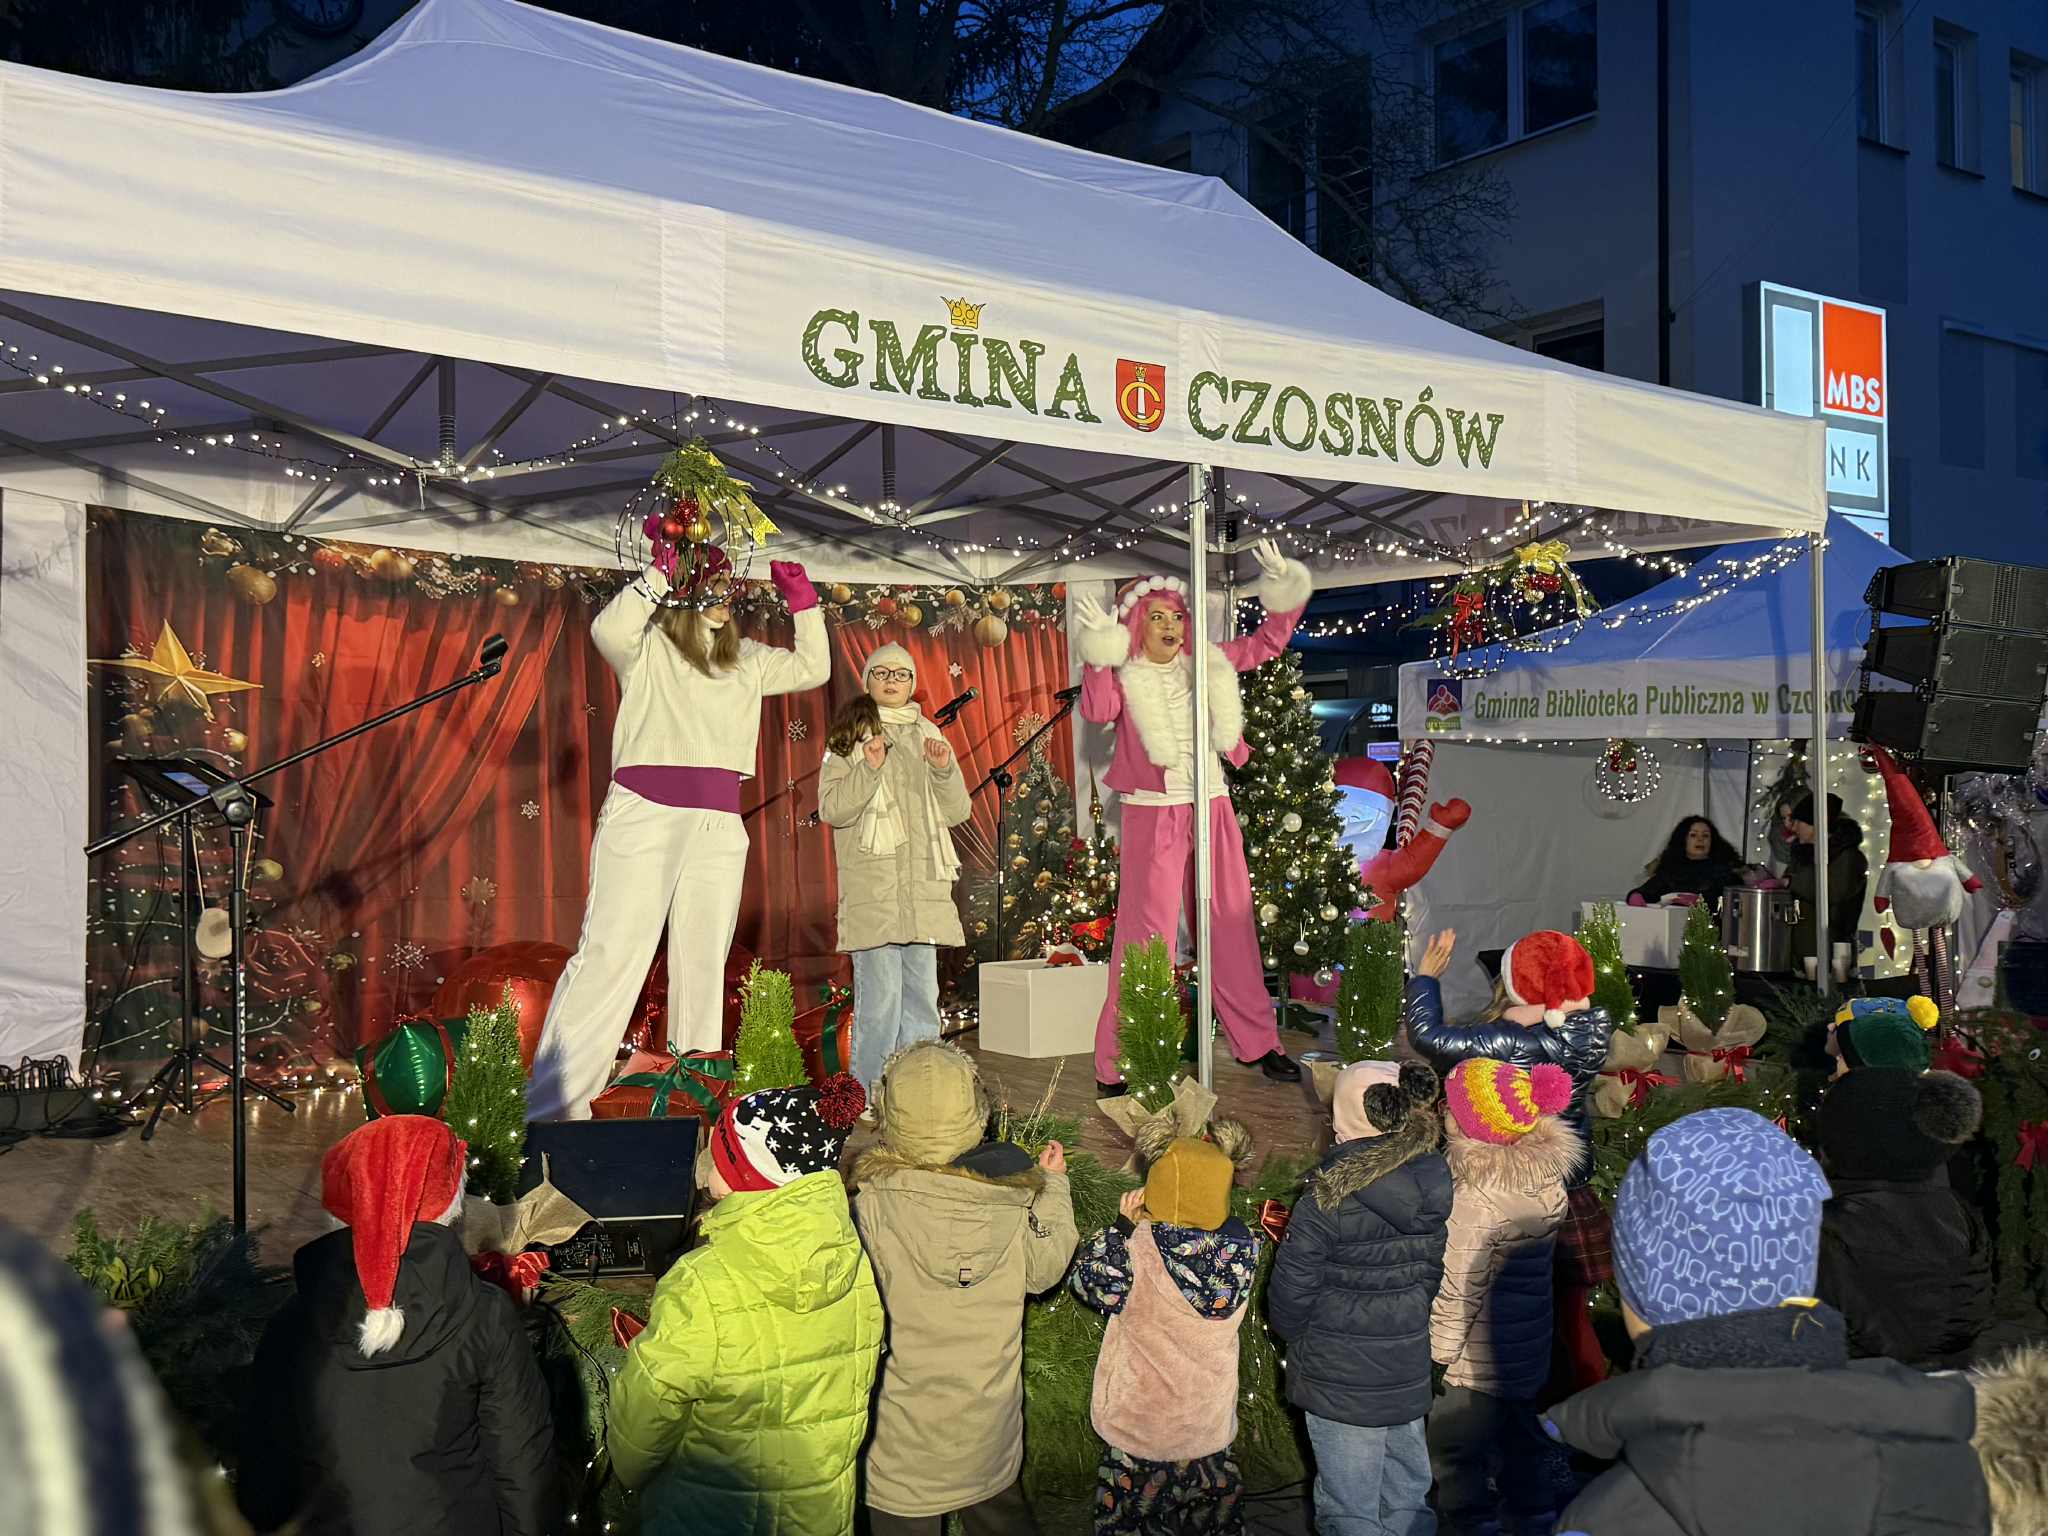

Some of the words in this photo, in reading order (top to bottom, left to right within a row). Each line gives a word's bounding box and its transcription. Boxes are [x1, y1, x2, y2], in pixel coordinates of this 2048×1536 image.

[802, 308, 1102, 424] GMINA
[1187, 371, 1505, 470] CZOSNÓW
[1826, 368, 1880, 413] MBS
[1474, 691, 1539, 719] Gminna
[1546, 687, 1638, 717] Biblioteka
[1646, 685, 1744, 714] Publiczna
[1752, 691, 1769, 714] w
